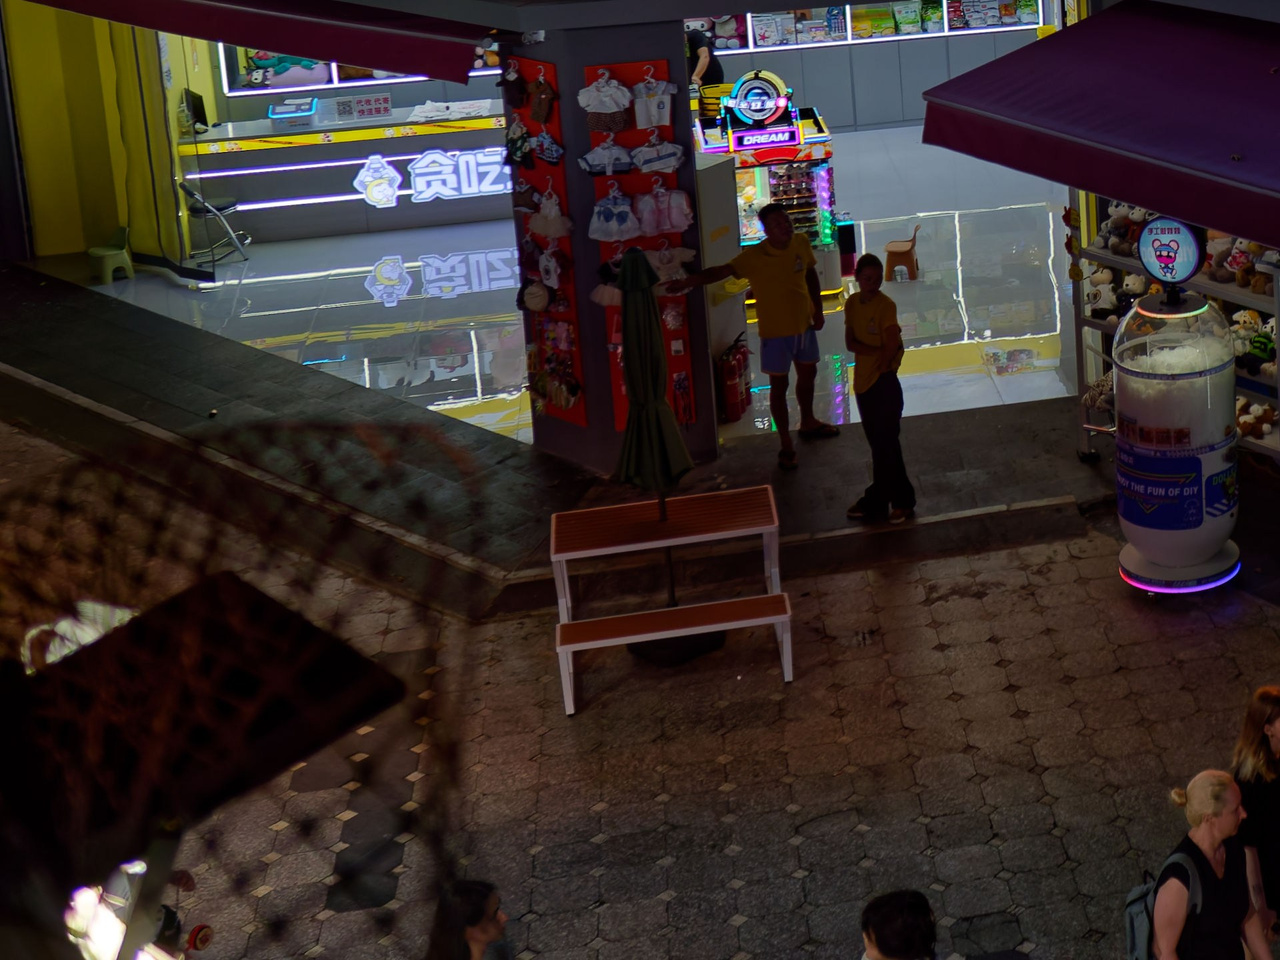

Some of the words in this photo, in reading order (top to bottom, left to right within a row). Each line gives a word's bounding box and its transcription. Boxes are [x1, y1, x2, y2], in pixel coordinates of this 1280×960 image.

[743, 132, 790, 145] DREAM
[409, 150, 514, 202] 贪吃
[1131, 482, 1145, 494] THE
[1147, 486, 1166, 496] FUN
[1168, 487, 1182, 497] OF
[1183, 486, 1199, 496] DIY
